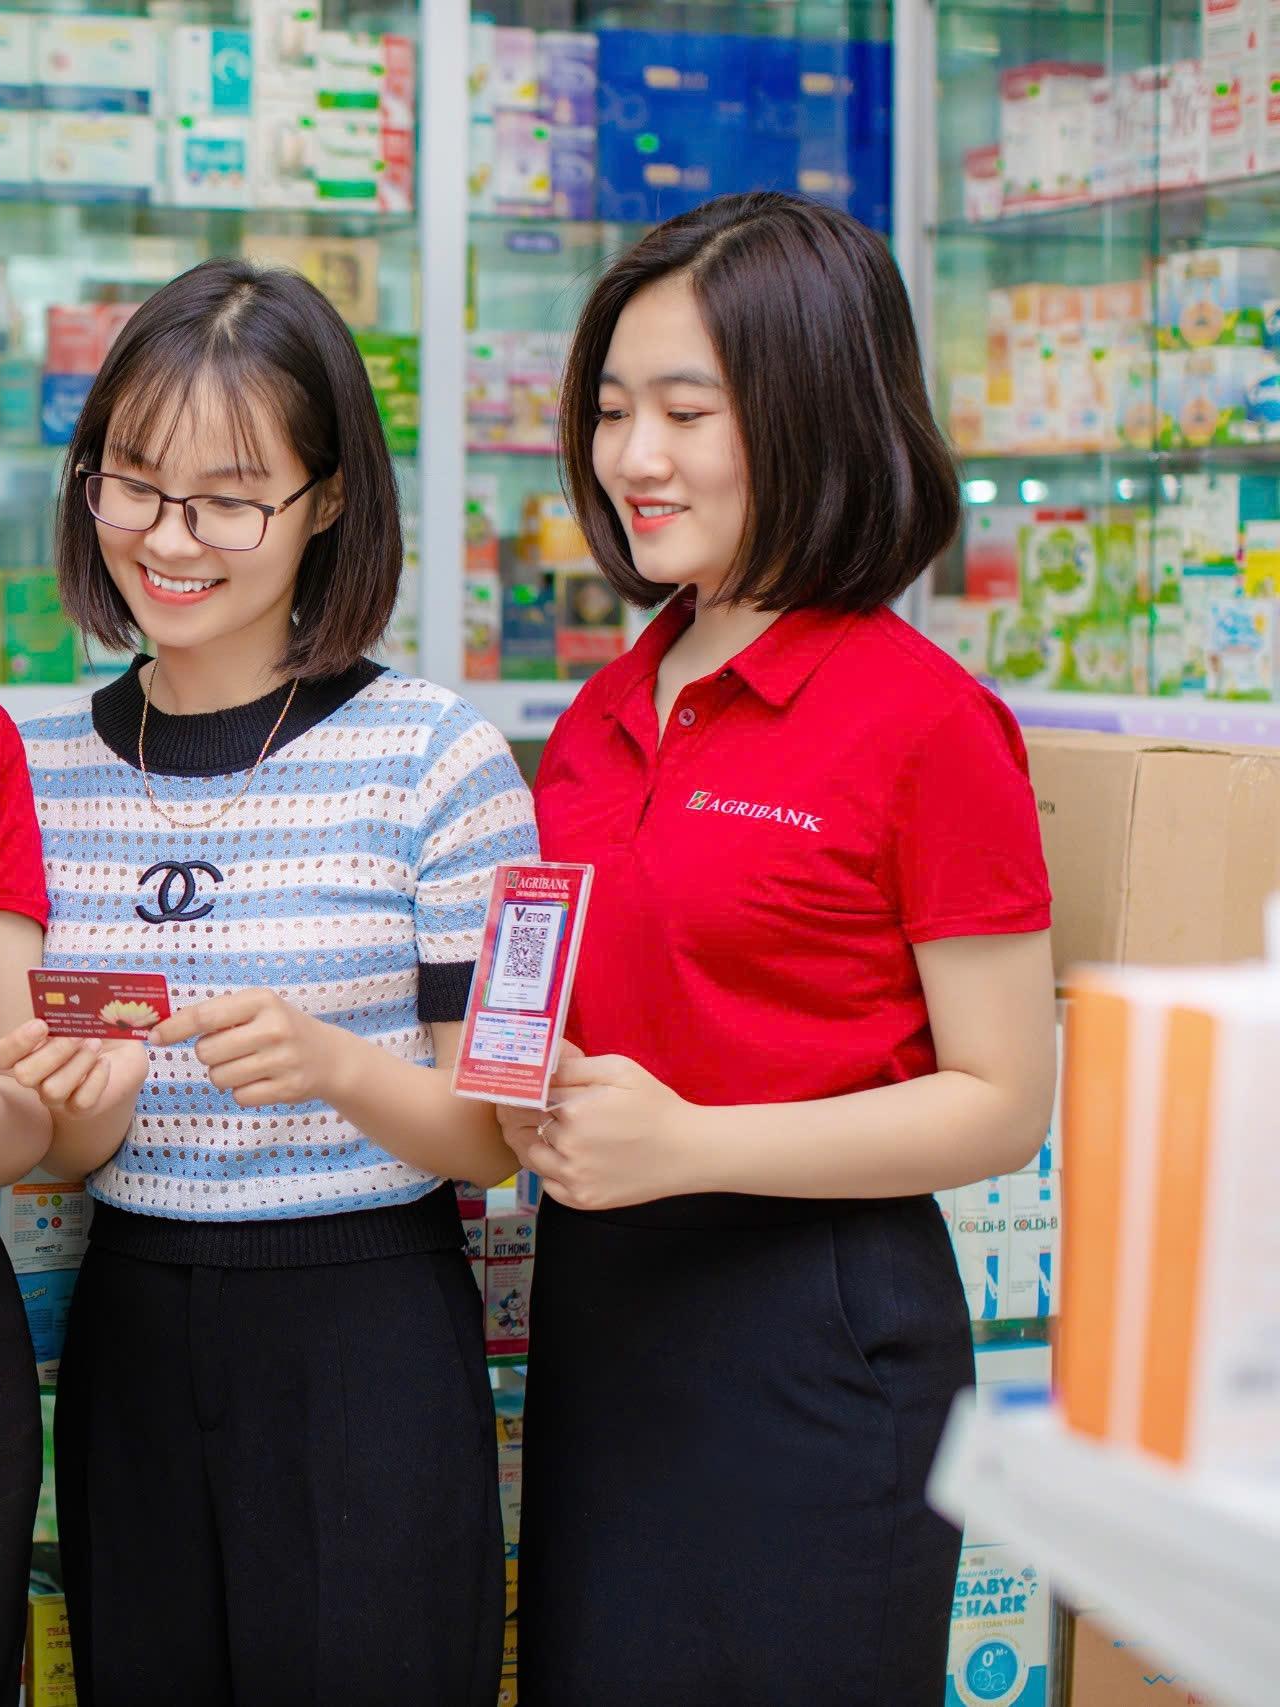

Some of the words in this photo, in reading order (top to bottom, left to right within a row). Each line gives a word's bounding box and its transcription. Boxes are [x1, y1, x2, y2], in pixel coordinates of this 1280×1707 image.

[705, 797, 825, 833] AGRIBANK
[517, 877, 570, 891] AGRIBANK
[954, 1576, 1015, 1598] BABY
[951, 1594, 1028, 1619] SHARK
